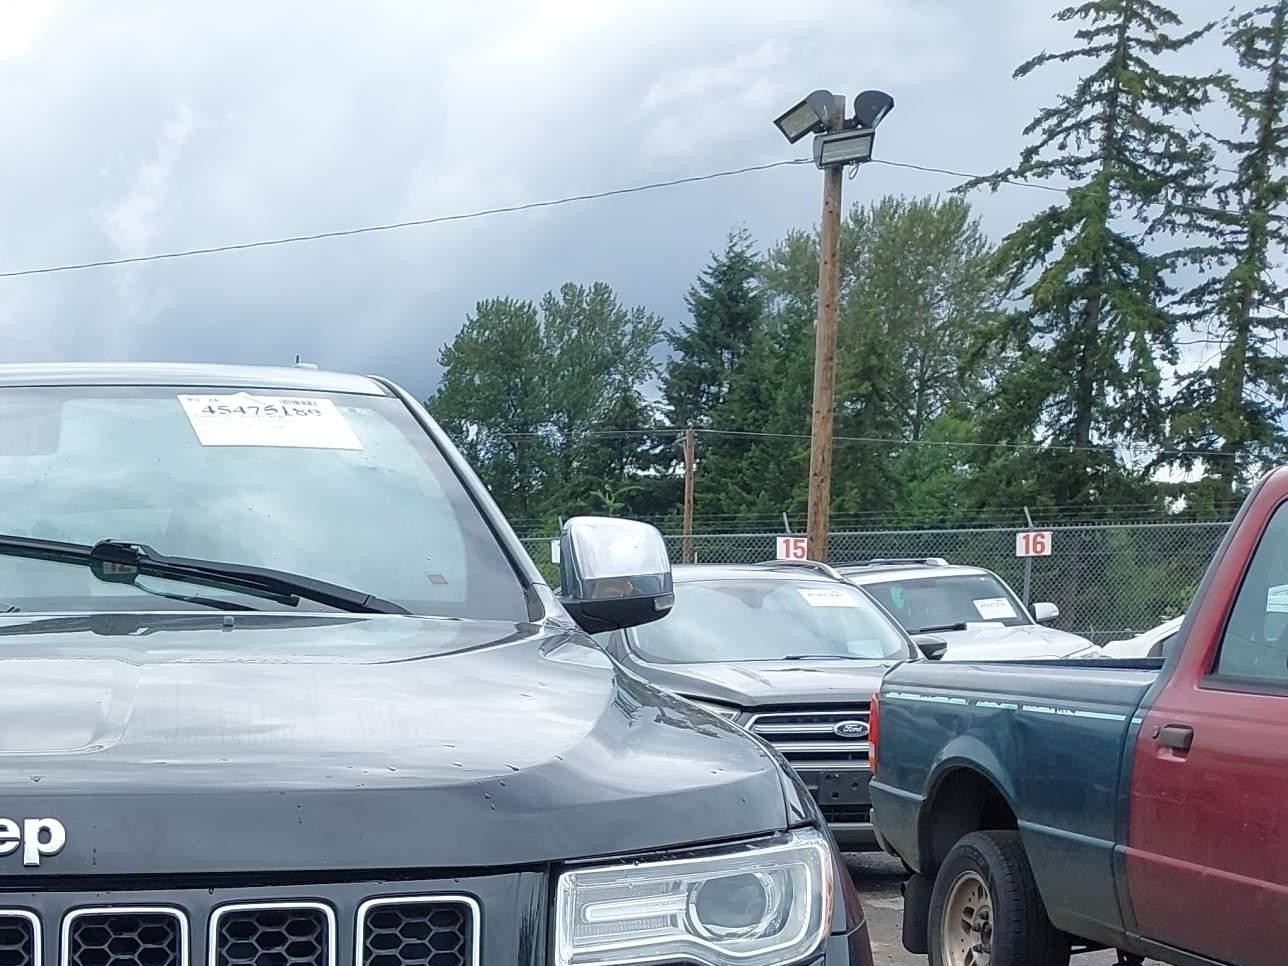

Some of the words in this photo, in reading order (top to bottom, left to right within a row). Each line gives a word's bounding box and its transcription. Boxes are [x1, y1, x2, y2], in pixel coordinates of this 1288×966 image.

[782, 538, 806, 559] 15
[1022, 533, 1046, 555] 16
[843, 724, 863, 733] Ford
